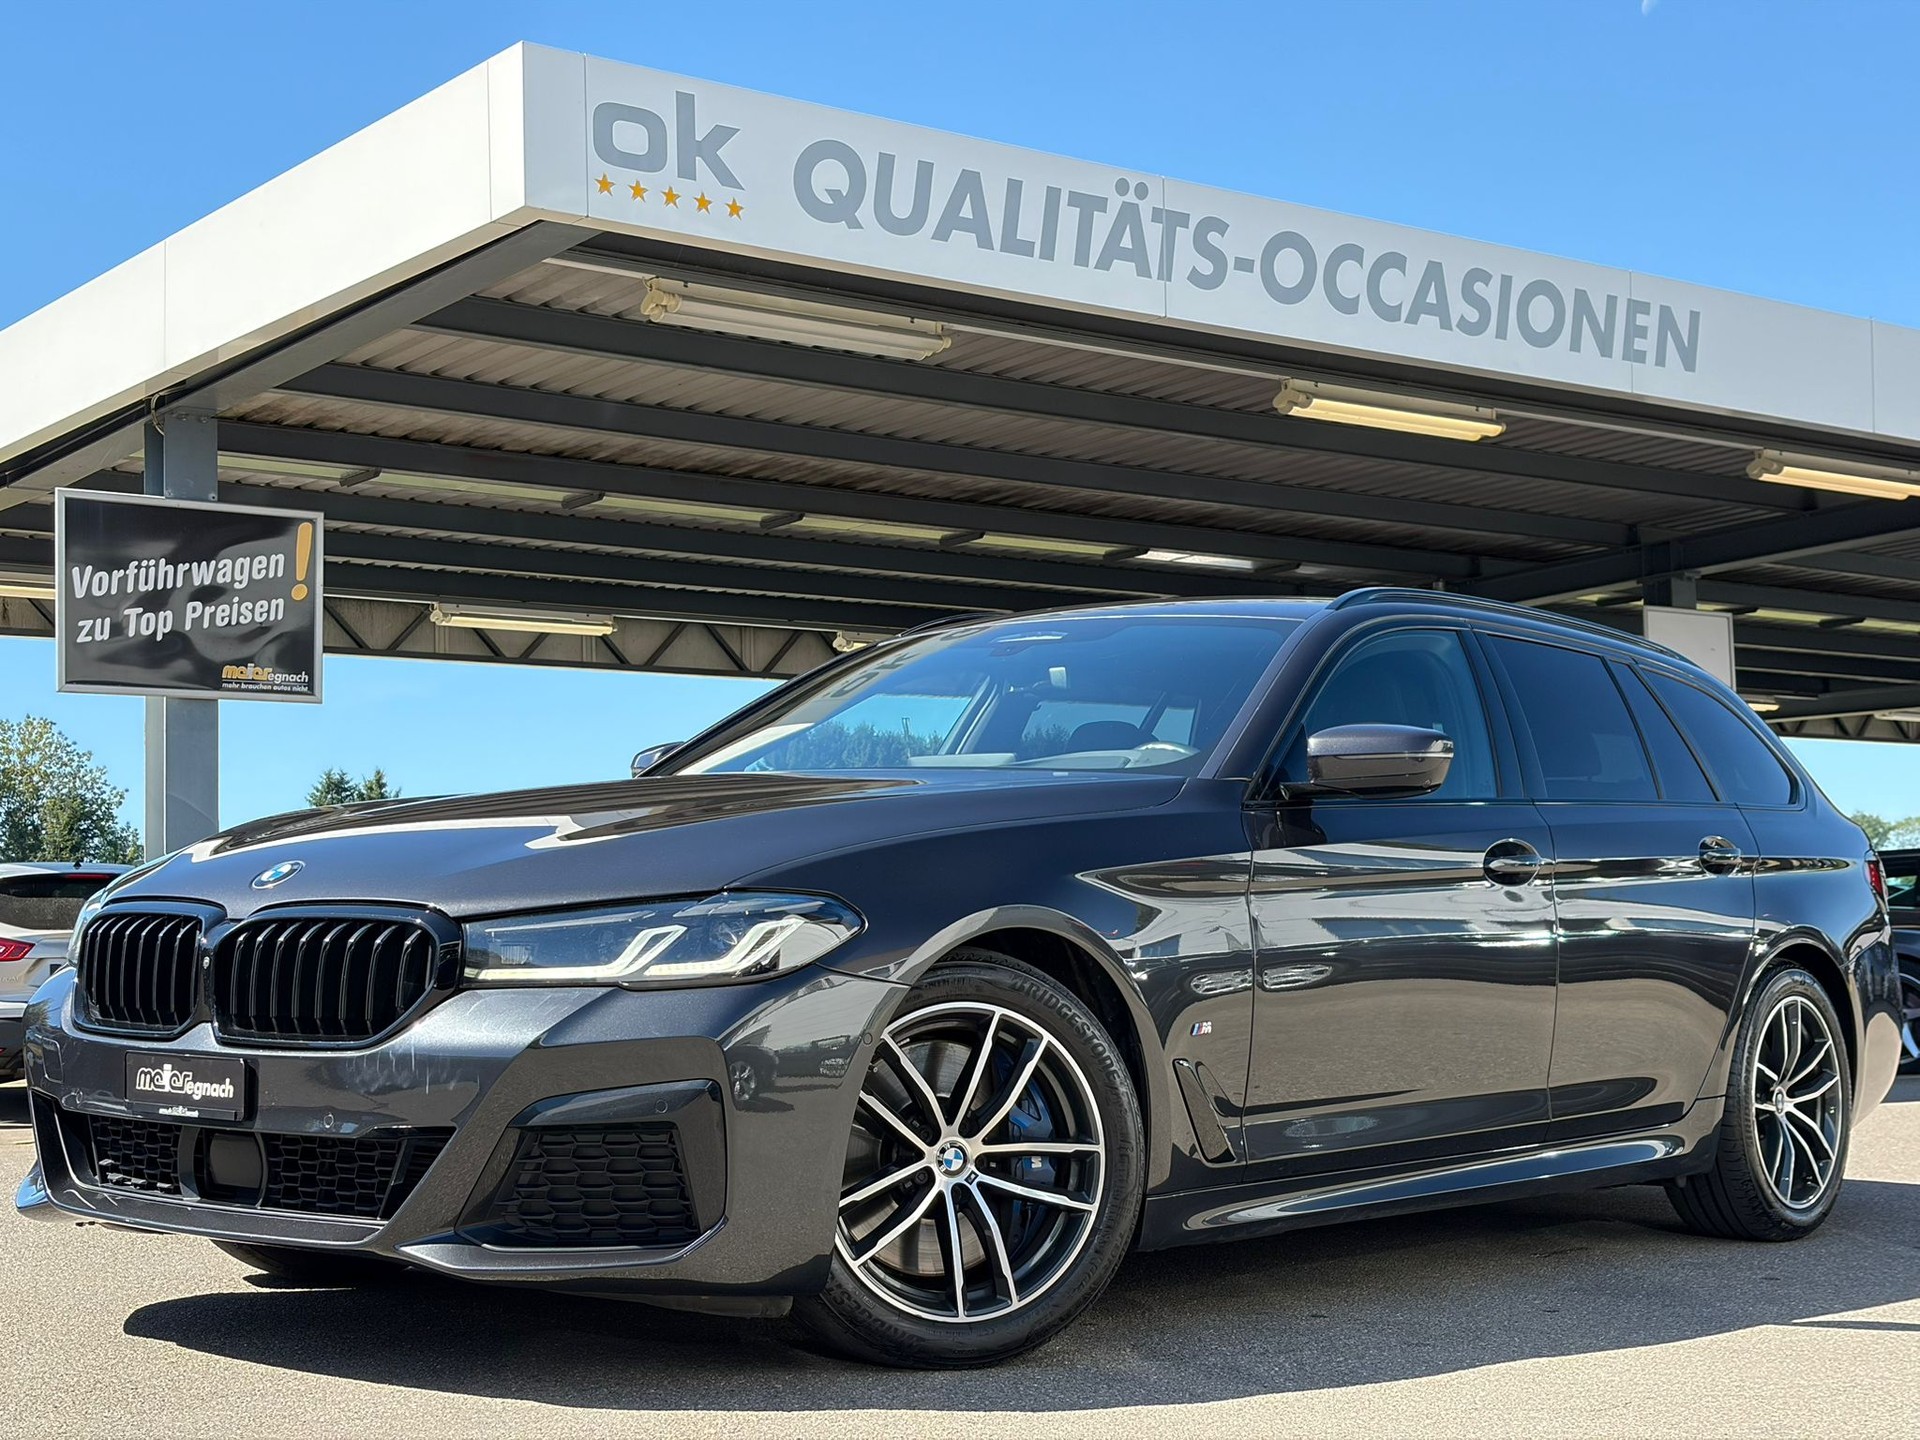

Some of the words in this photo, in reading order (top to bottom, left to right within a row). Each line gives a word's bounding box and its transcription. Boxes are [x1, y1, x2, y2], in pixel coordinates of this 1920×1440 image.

[592, 90, 746, 191] ok
[792, 138, 1701, 373] QUALITÄTS-OCCASIONEN
[71, 552, 286, 599] Vorführwagen
[76, 616, 112, 643] zu
[122, 607, 174, 642] Top
[184, 596, 286, 631] Preisen
[241, 683, 272, 691] brauchen
[292, 684, 309, 692] nicht
